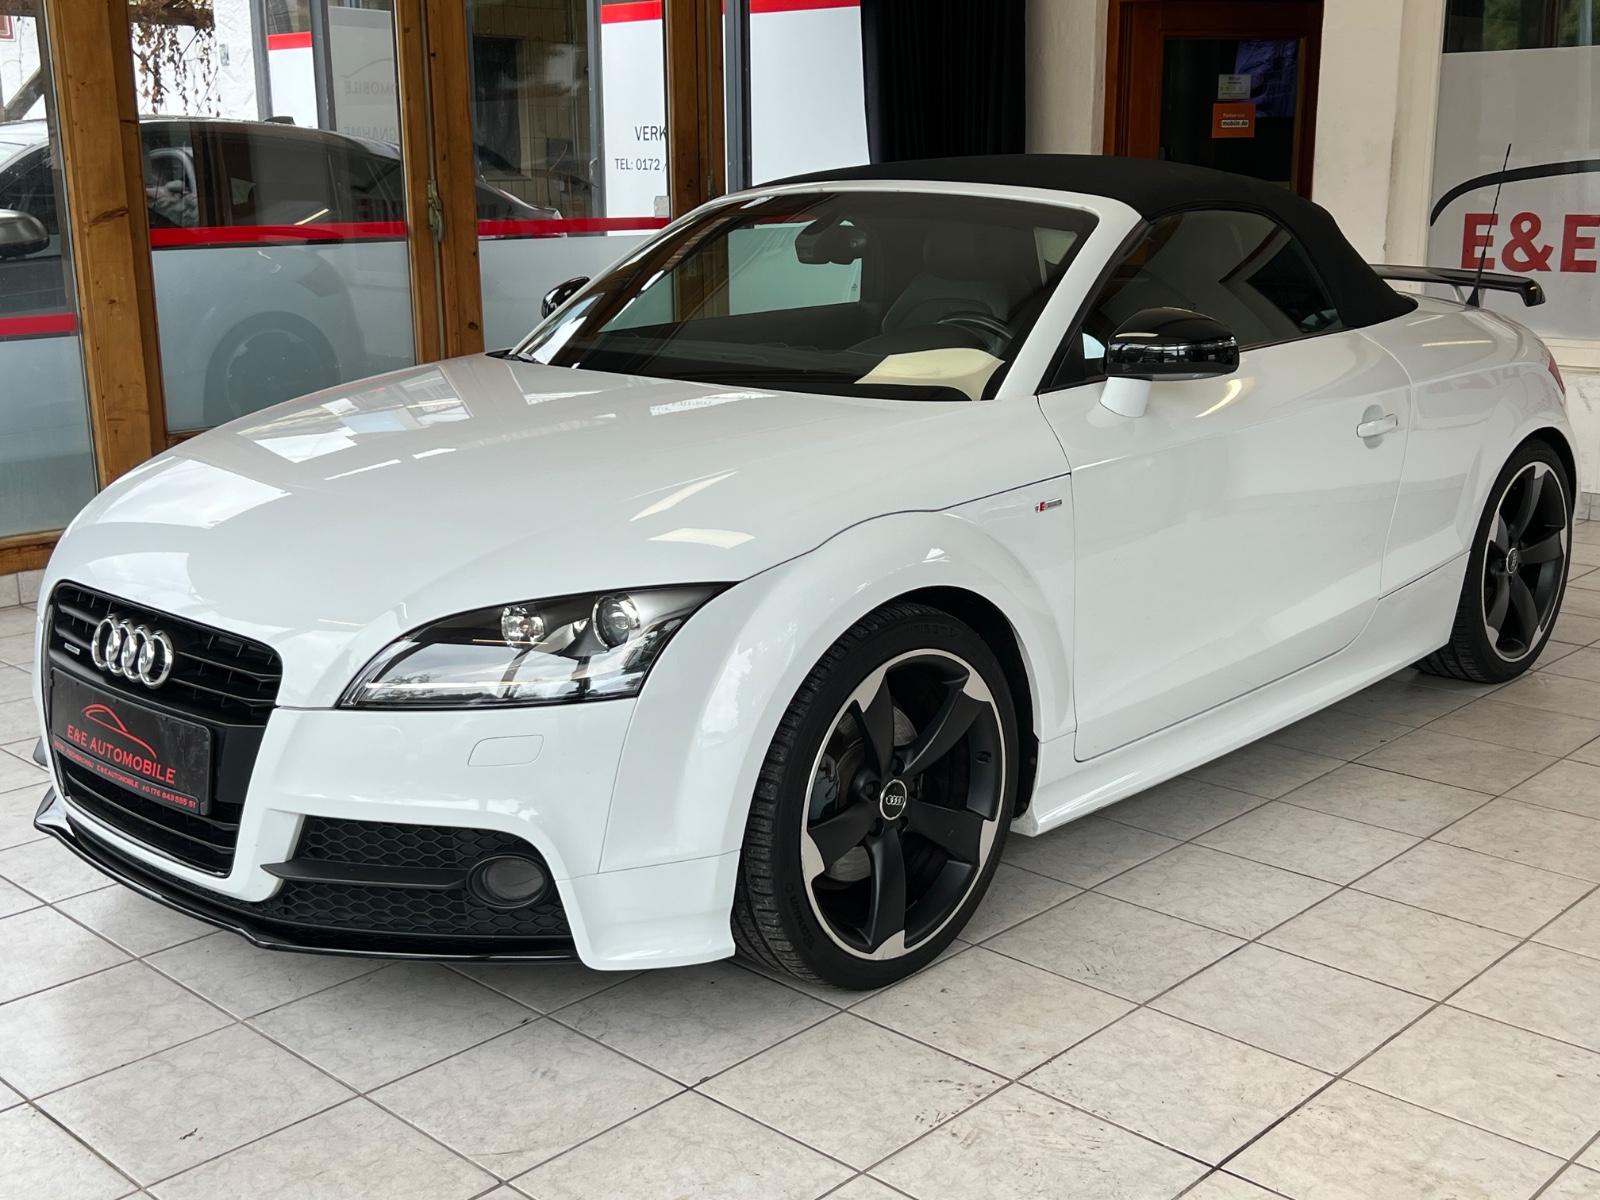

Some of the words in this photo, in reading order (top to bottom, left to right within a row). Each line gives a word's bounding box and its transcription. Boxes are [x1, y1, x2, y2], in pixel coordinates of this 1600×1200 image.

[614, 158, 633, 170] TEL:
[635, 158, 660, 171] 0172
[1461, 211, 1600, 273] E&E
[67, 724, 88, 747] E&E
[90, 737, 176, 785] AUTOMOBILE
